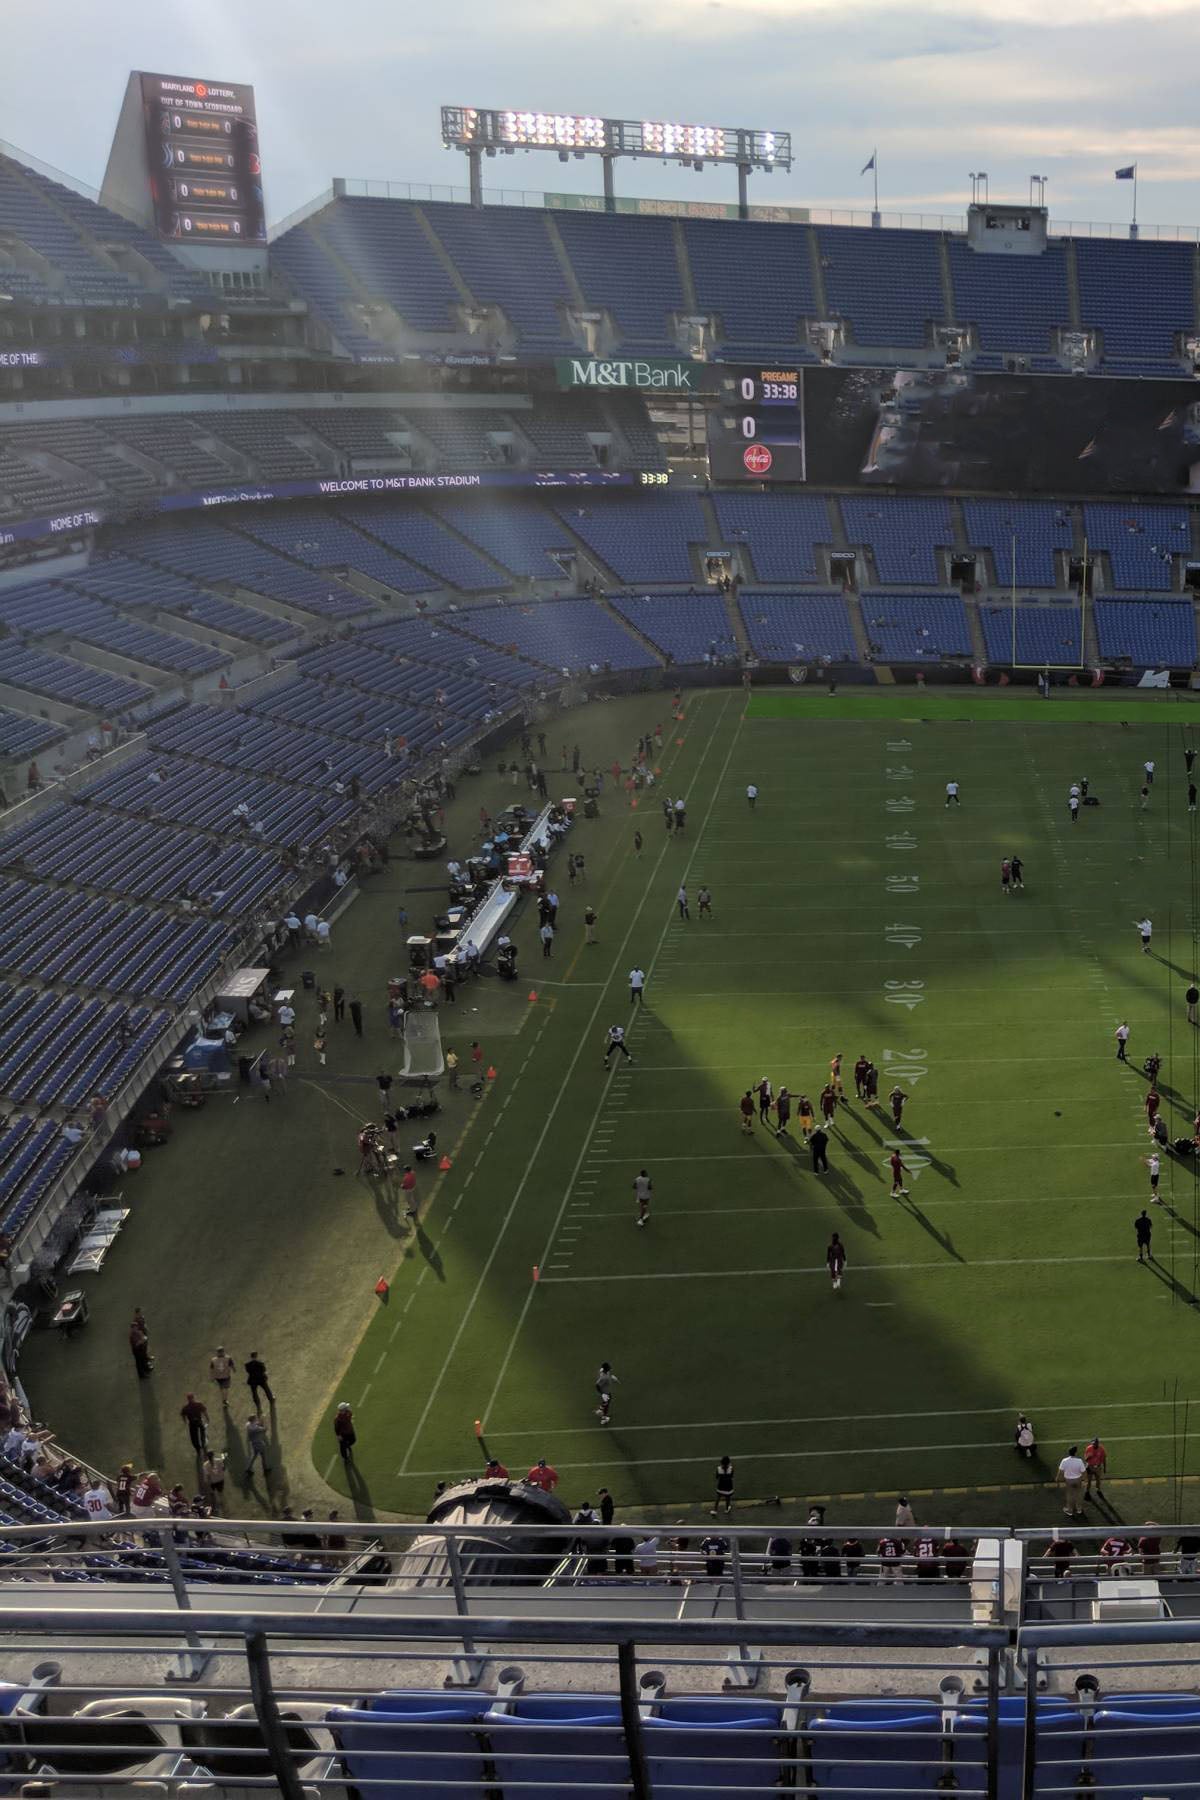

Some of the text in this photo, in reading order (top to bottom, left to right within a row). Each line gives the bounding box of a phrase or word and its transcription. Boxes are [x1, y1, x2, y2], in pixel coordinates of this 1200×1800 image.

[571, 360, 692, 387] M&T Bank
[761, 371, 798, 383] PREGAME
[741, 379, 798, 400] 0 33:38
[742, 417, 755, 438] 0
[320, 474, 481, 493] WELCOME TO M&T BANK STADIUM
[641, 473, 669, 484] 33:38
[50, 517, 72, 532] HOME
[73, 514, 83, 526] OF
[87, 1498, 102, 1512] 30
[919, 1543, 934, 1558] 21
